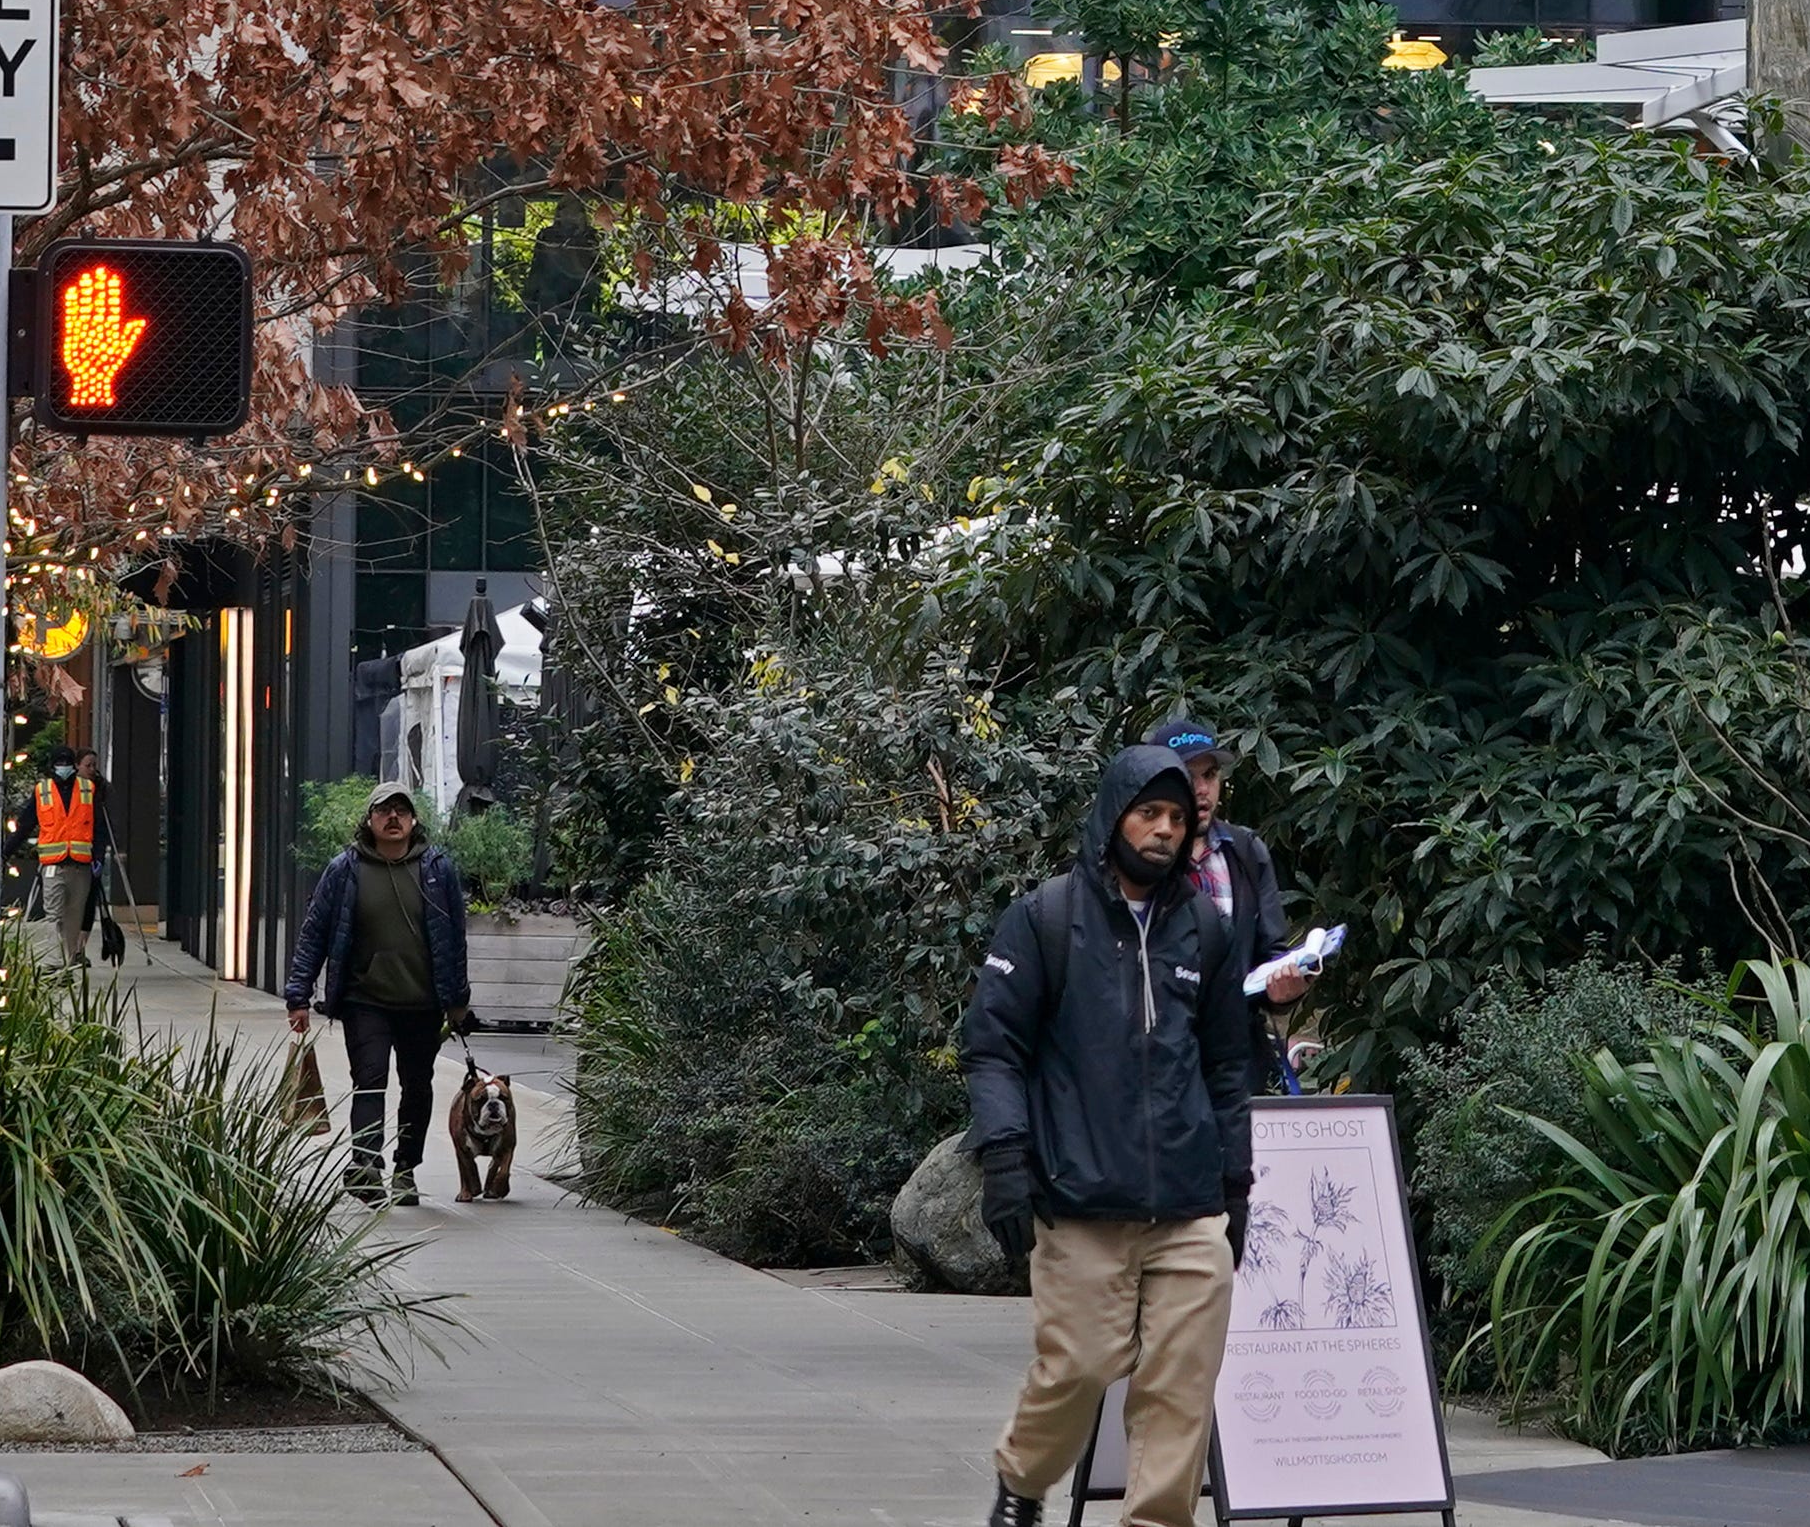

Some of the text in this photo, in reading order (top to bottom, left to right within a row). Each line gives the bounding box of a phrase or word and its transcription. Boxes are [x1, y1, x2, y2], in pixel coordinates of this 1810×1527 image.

[1253, 1120, 1366, 1139] OTT'S GHOST
[1226, 1337, 1402, 1356] RESTAURANT AT THE SPHERES
[1234, 1391, 1285, 1401] RESTAURANT
[1294, 1388, 1348, 1400] FOOD TO-GO
